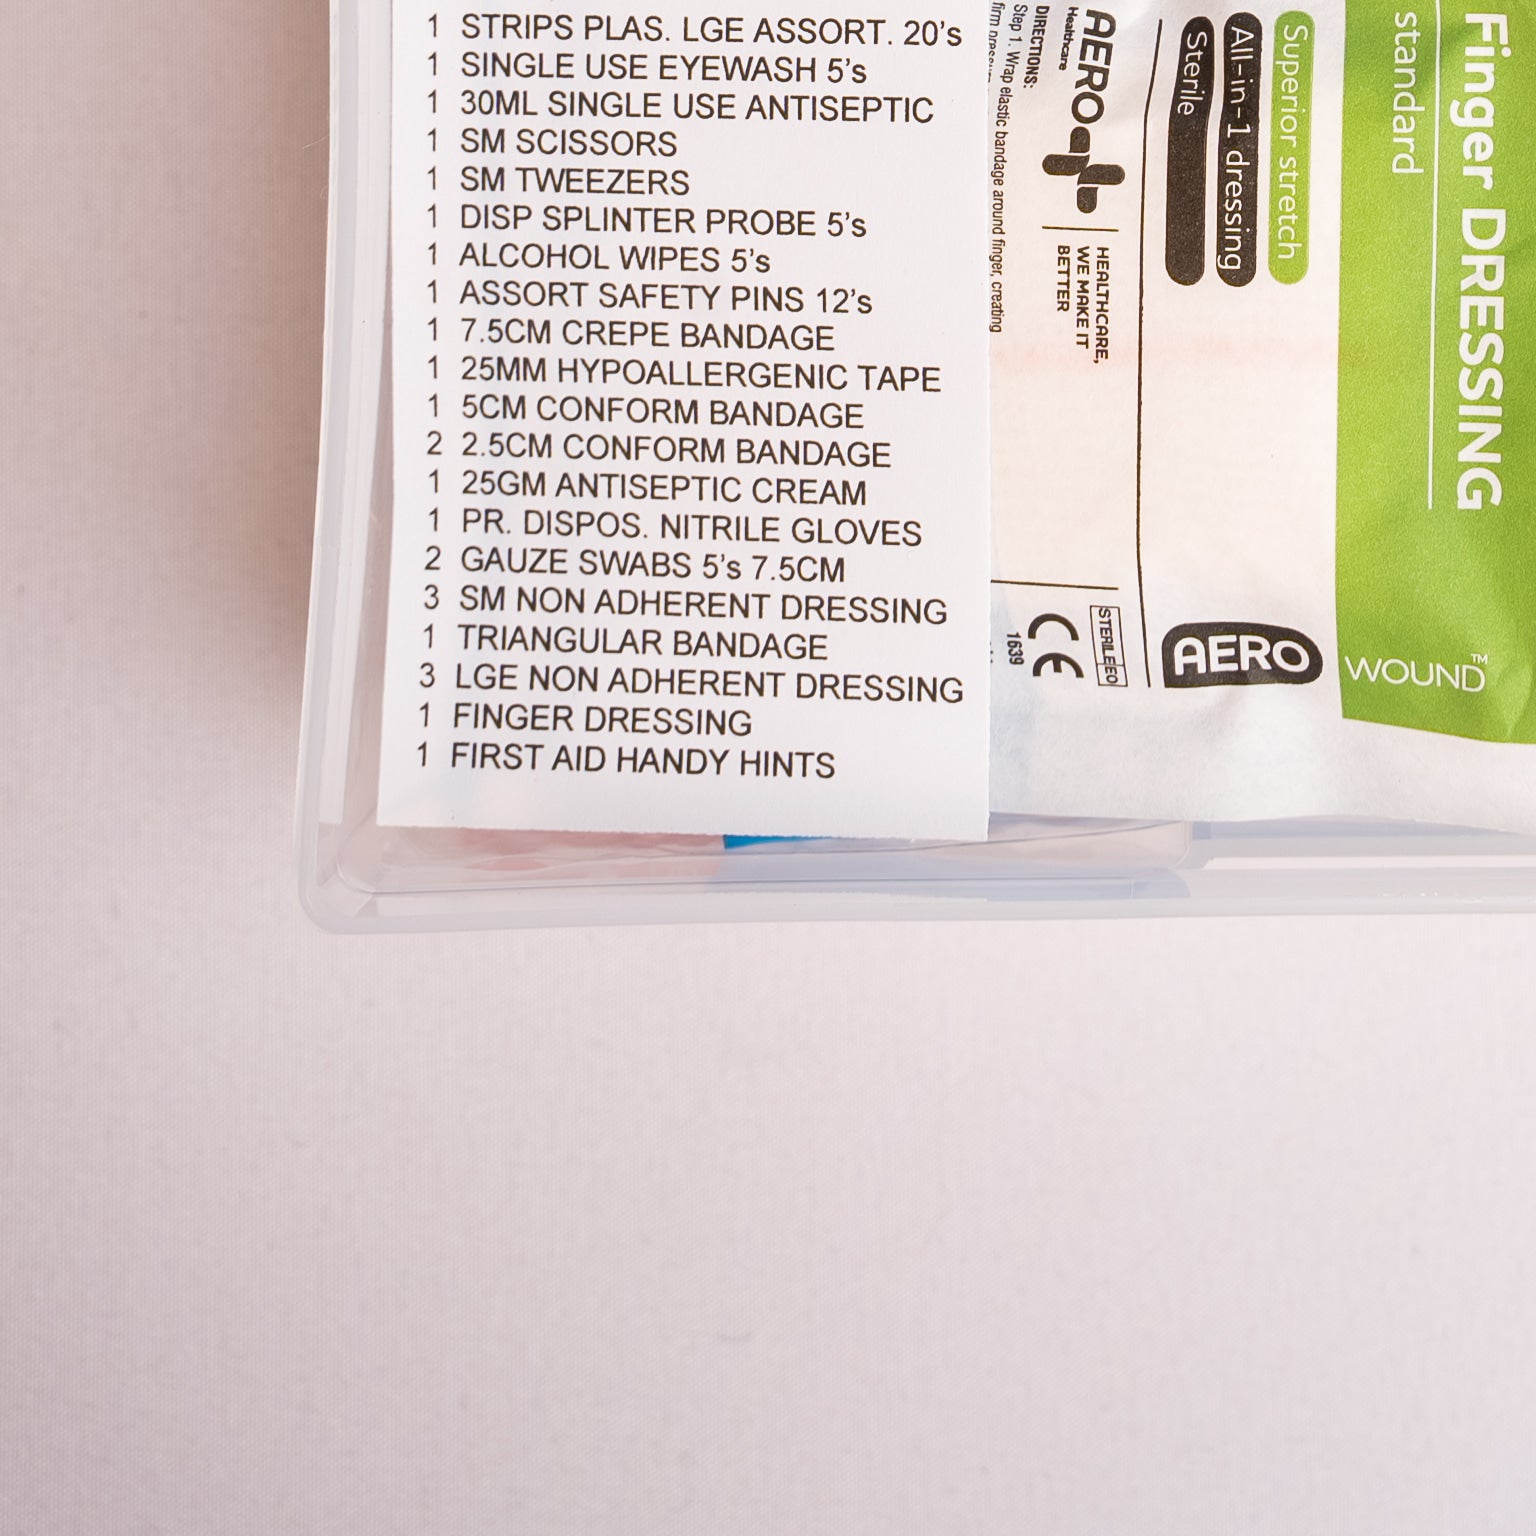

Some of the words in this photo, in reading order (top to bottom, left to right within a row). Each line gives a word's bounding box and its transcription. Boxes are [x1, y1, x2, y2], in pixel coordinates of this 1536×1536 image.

[428, 13, 437, 38] 1
[461, 13, 574, 41] STRIPS
[584, 15, 670, 42] PLAS.
[683, 16, 744, 43] LGE
[752, 17, 892, 45] ASSORT.
[903, 20, 962, 47] 20's
[1008, 4, 1028, 31] Step
[1023, 5, 1050, 89] DIRECTIONS:
[1059, 6, 1078, 70] Healthcare
[428, 52, 437, 76] 1
[461, 51, 575, 79] SINGLE
[586, 53, 648, 80] USE
[659, 54, 816, 83] EYEWASH
[827, 57, 867, 84] 5's
[1000, 51, 1021, 83] Wrap
[1071, 8, 1116, 124] AERO
[1177, 31, 1208, 116] Sterile
[1275, 24, 1308, 147] Superior
[428, 89, 437, 114] 1
[461, 89, 538, 116] 30ML
[548, 90, 662, 118] SINGLE
[673, 93, 736, 120] USE
[745, 94, 934, 124] ANTISEPTIC
[996, 87, 1013, 127] elastic
[1393, 12, 1423, 176] standard
[1450, 12, 1511, 192] Finger
[428, 128, 436, 152] 1
[460, 127, 505, 154] SM
[516, 128, 677, 158] SCISSORS
[991, 131, 1008, 186] bandage
[427, 166, 436, 190] 1
[460, 165, 505, 192] SM
[514, 167, 690, 196] TWEEZERS
[993, 190, 1005, 235] around
[1217, 149, 1250, 270] dressing
[1278, 157, 1302, 259] stretch
[428, 242, 436, 265] 1
[458, 242, 610, 270] ALCOHOL
[619, 245, 720, 273] WIPES
[731, 248, 771, 274] 5's
[989, 239, 1005, 277] finger,
[1078, 246, 1089, 266] WE
[1057, 245, 1070, 312] BETTER
[989, 282, 1005, 333] creating
[1077, 273, 1089, 328] MAKE
[1093, 246, 1110, 363] HEALTHCARE,
[428, 317, 437, 341] 1
[461, 317, 551, 345] 7.5CM
[562, 319, 670, 347] CREPE
[681, 322, 835, 351] BANDAGE
[1076, 332, 1088, 349] IT
[428, 355, 437, 379] 1
[461, 355, 546, 382] 25MM
[558, 358, 848, 391] HYPOALLERGENIC
[857, 364, 941, 393] TAPE
[1457, 207, 1506, 512] DRESSING
[429, 469, 438, 493] 1
[462, 469, 546, 497] 25GM
[555, 472, 742, 503] ANTISEPTIC
[752, 477, 866, 506] CREAM
[424, 623, 433, 649] 1
[457, 624, 663, 655] TRIANGULAR
[673, 630, 828, 661] BANDAGE
[1173, 635, 1309, 676] AERO
[420, 702, 429, 727] 1
[453, 702, 574, 732] FINGER
[585, 706, 752, 737] DRESSING
[417, 741, 427, 767] 1
[451, 742, 545, 771] FIRST
[551, 744, 606, 772] AID
[617, 746, 730, 775] HANDY
[740, 750, 835, 779] HINTS
